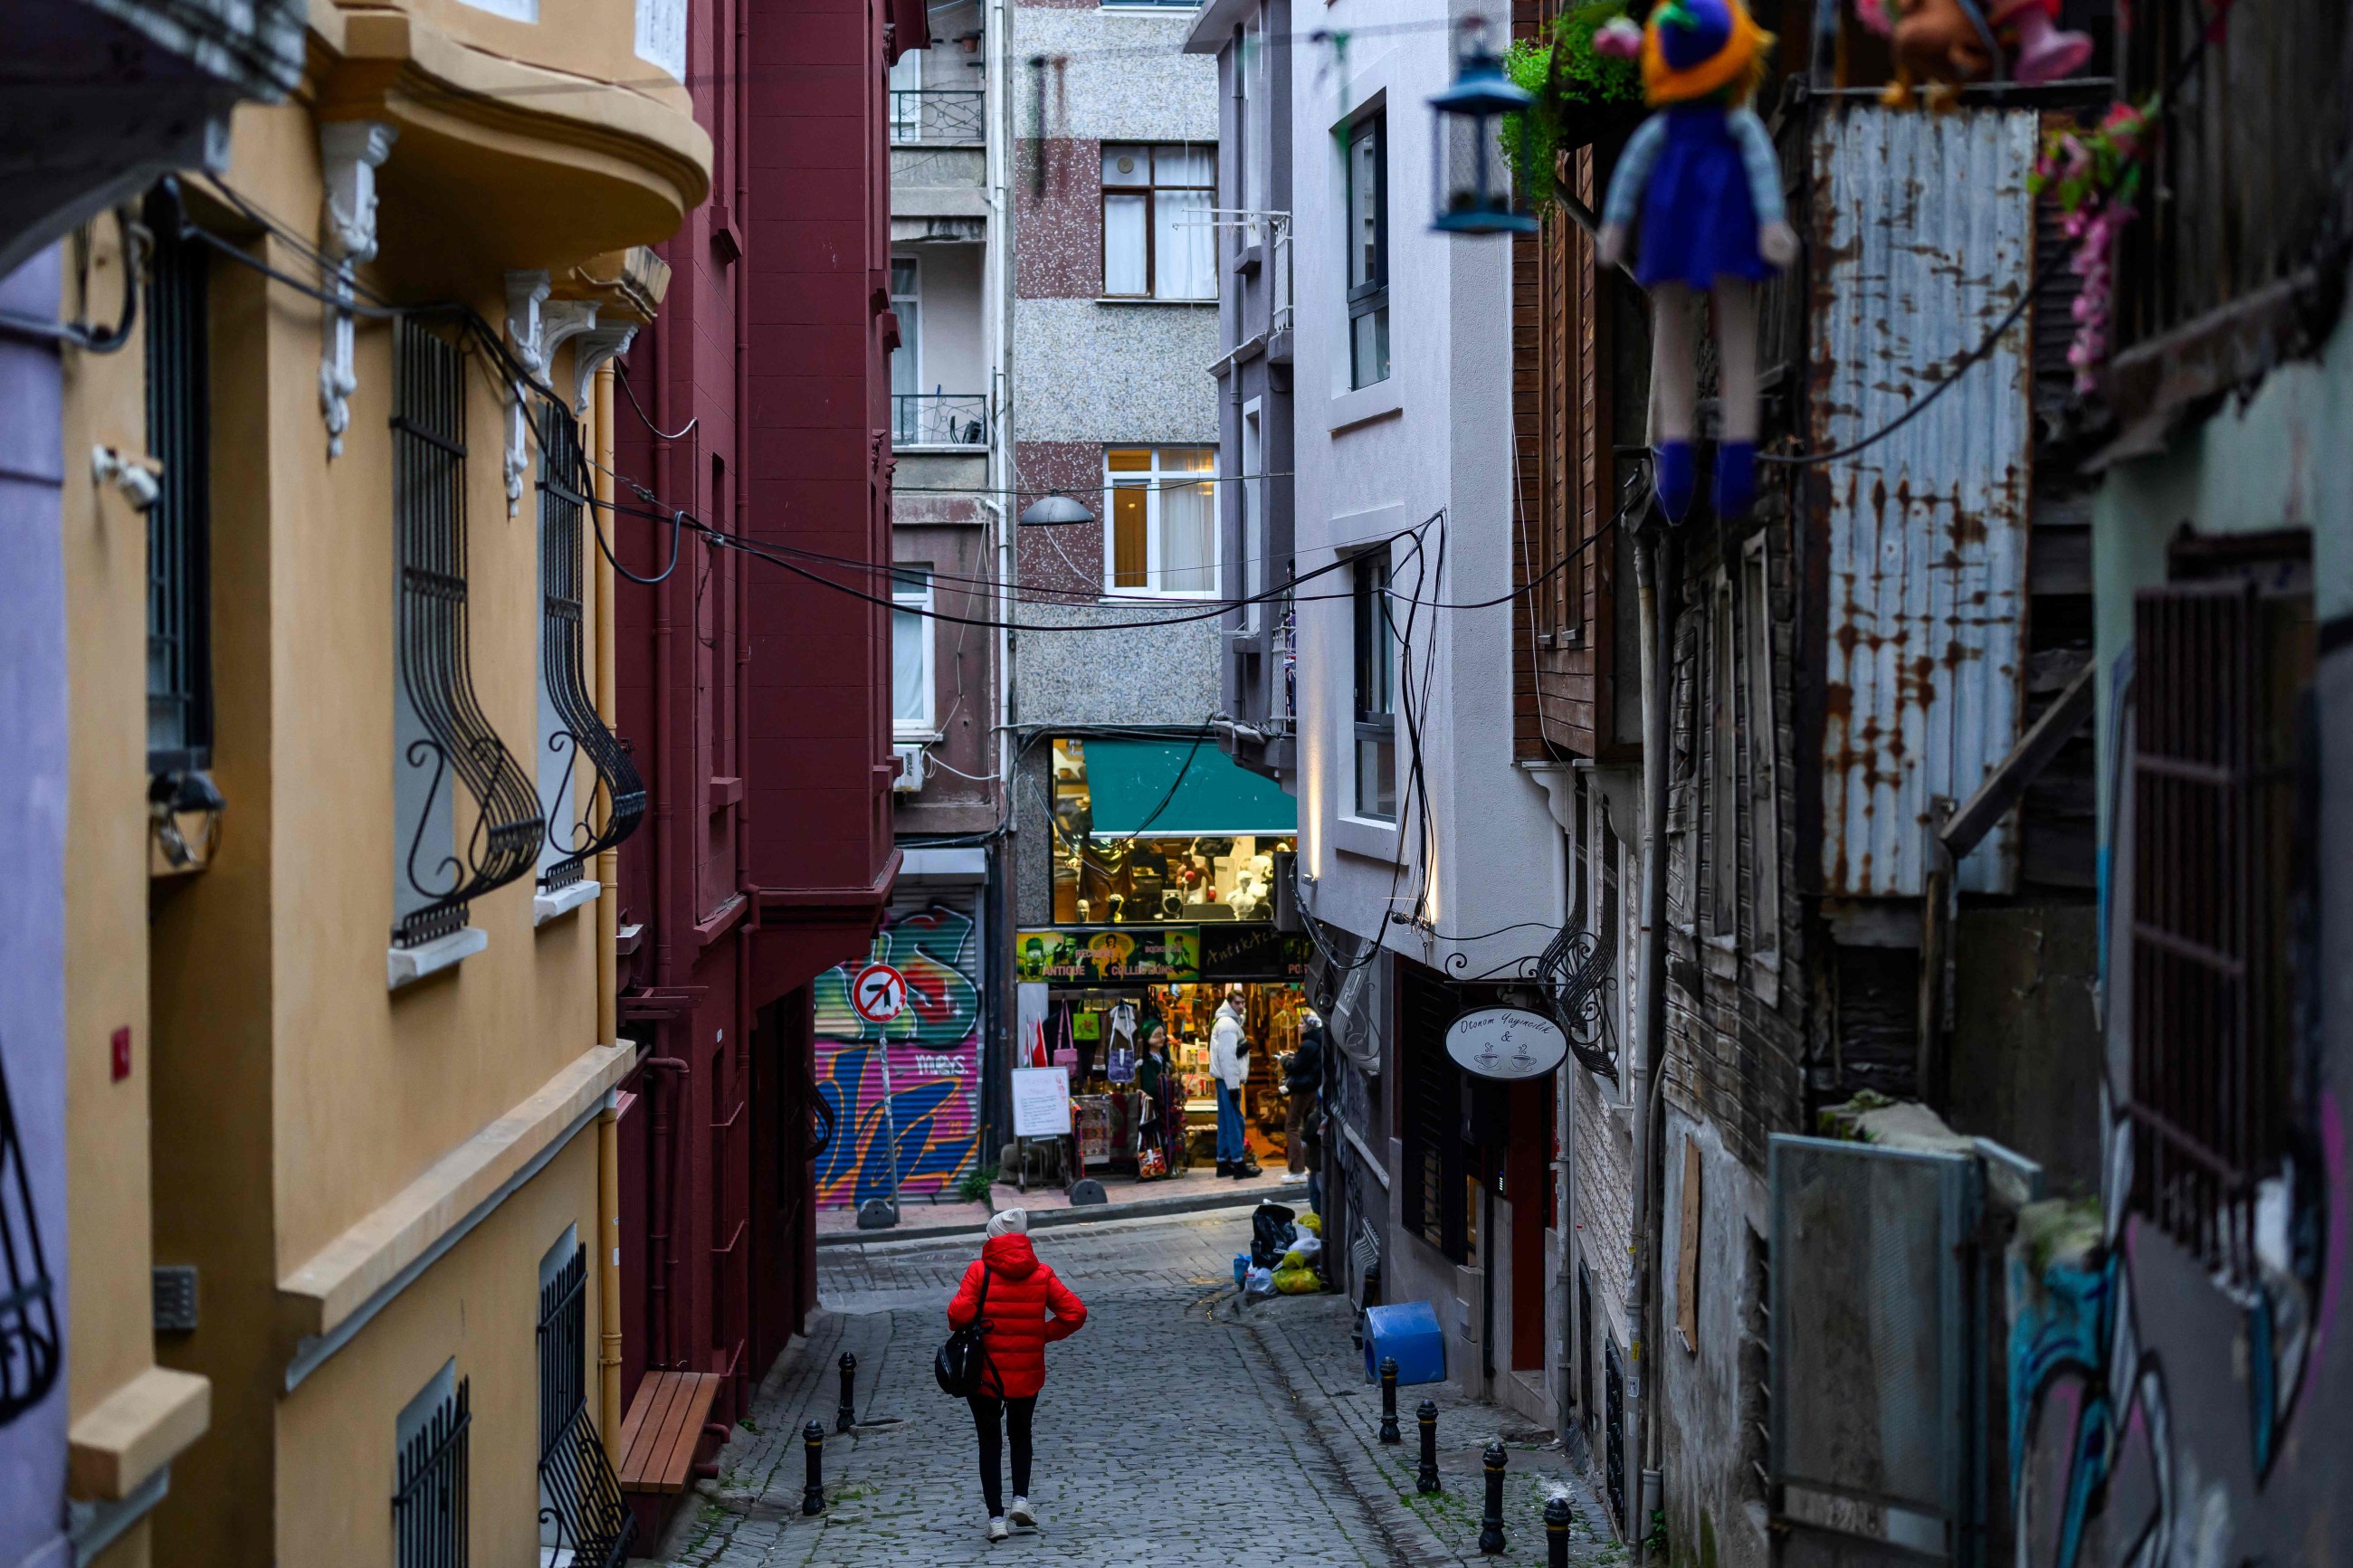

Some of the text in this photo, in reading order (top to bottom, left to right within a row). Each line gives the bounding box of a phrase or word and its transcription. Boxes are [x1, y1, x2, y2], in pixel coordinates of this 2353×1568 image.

[1043, 965, 1175, 976] ANTIQUE COLLECTIONS
[1461, 1018, 1495, 1033] Otonom
[1500, 1031, 1513, 1042] &
